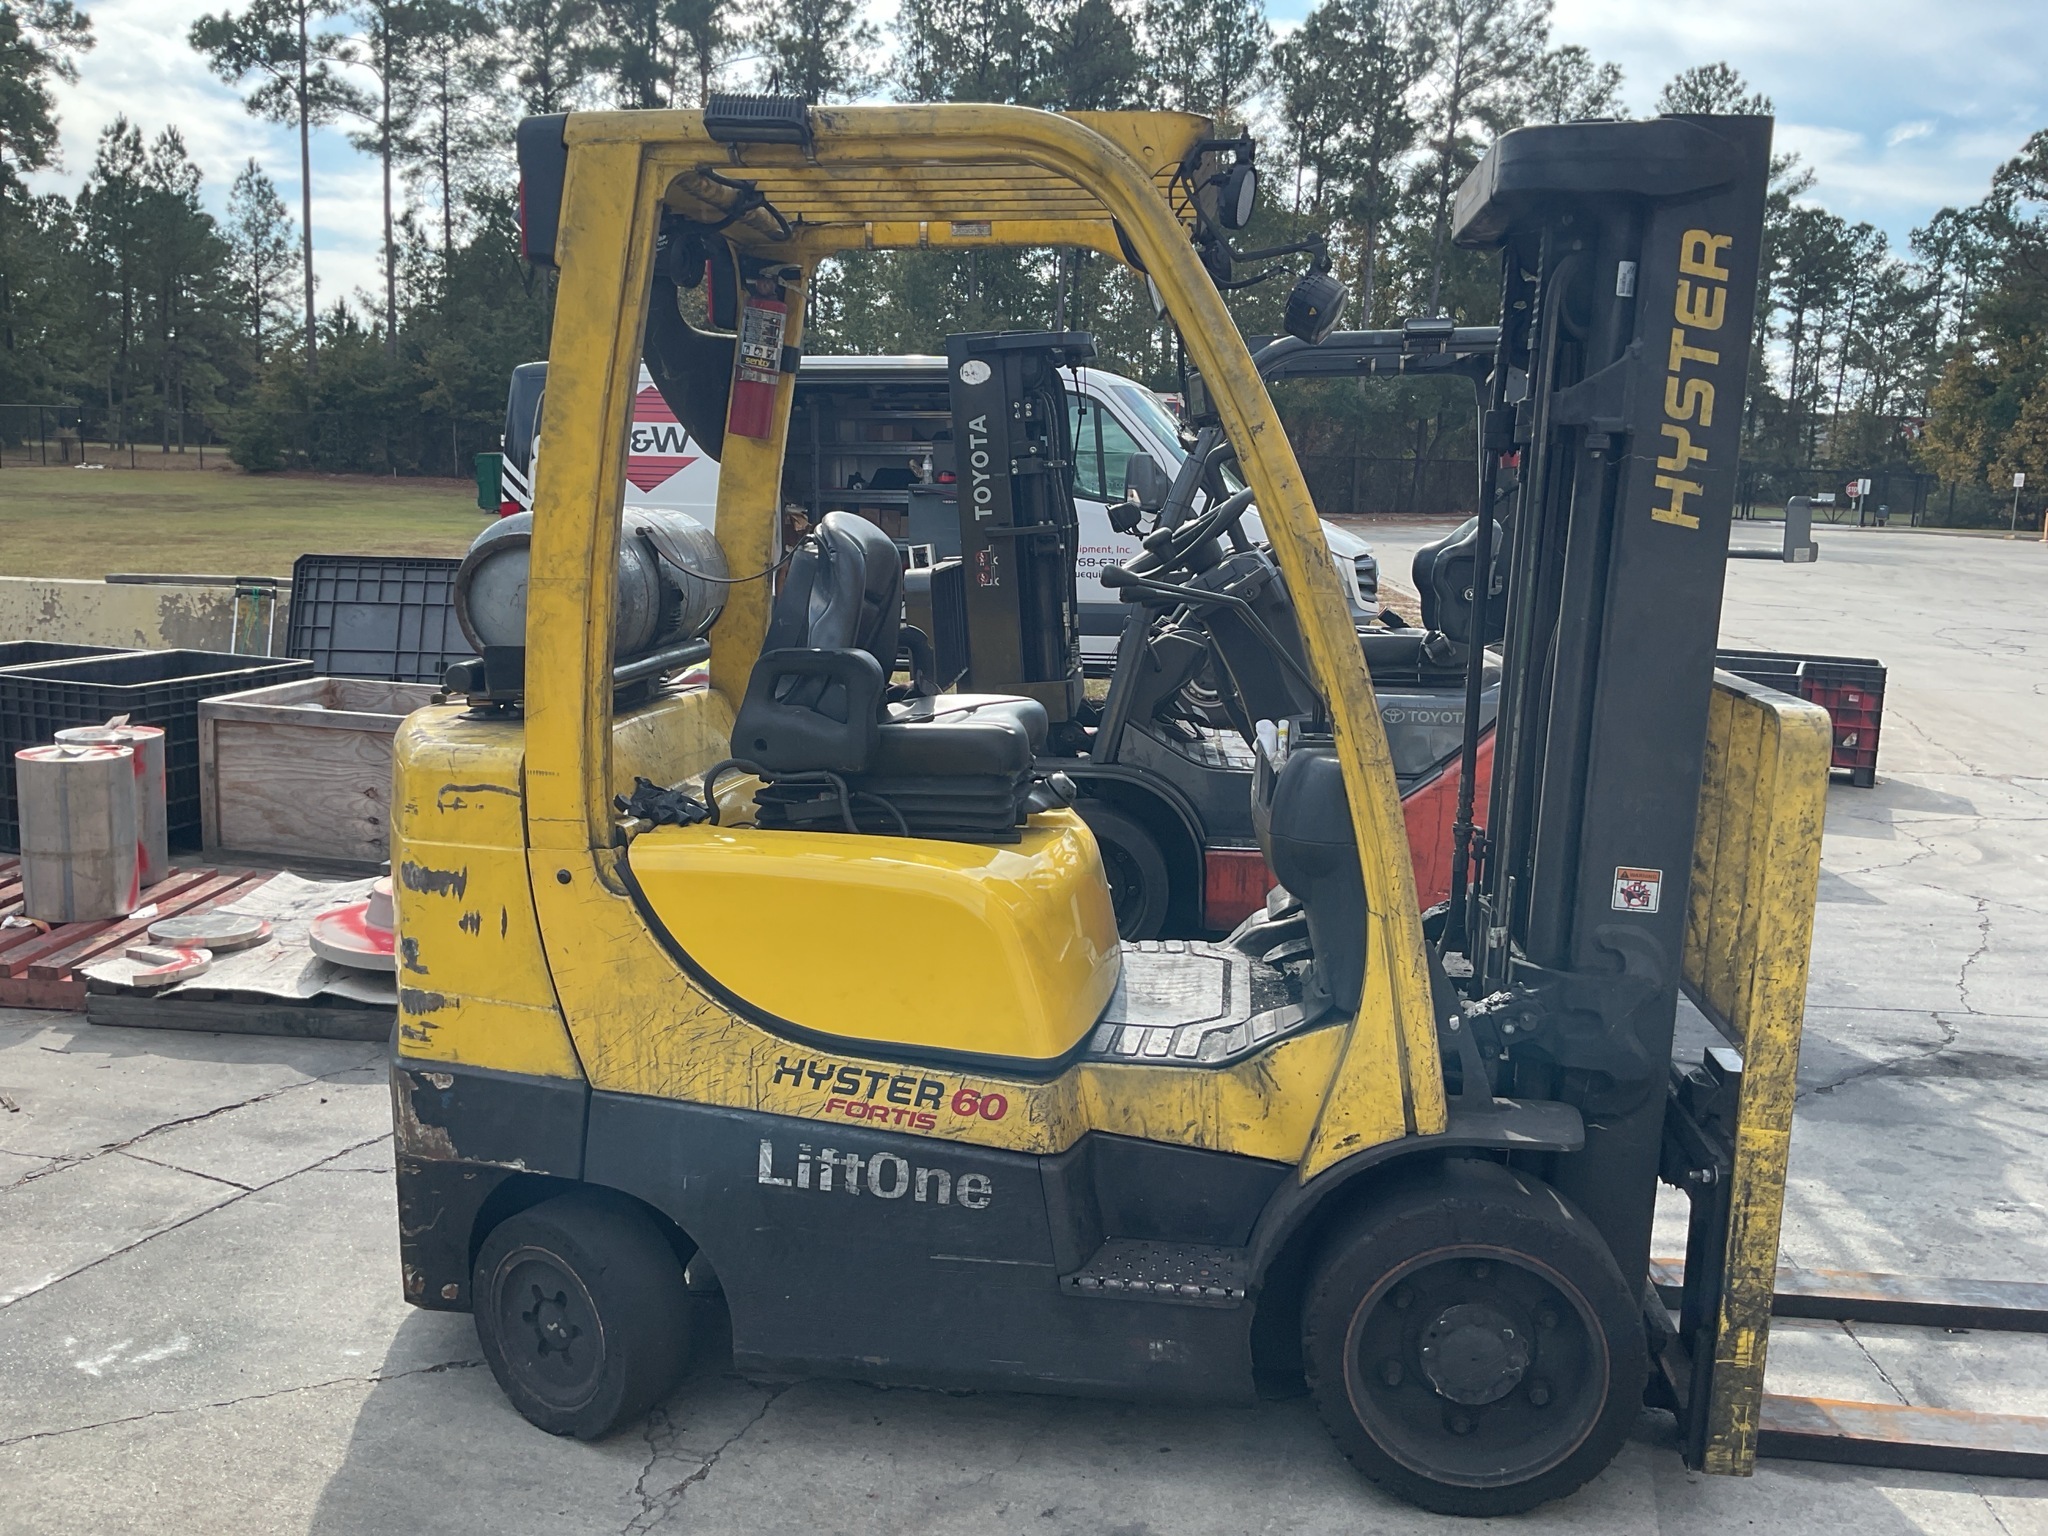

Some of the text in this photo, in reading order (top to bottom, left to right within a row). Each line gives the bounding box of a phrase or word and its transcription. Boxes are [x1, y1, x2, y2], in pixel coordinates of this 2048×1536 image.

[745, 356, 771, 368] sentry
[1651, 229, 1733, 530] HYSTER
[630, 426, 688, 454] &W
[968, 413, 993, 521] TOYOTA
[1077, 557, 1128, 568] 68-6316
[1079, 545, 1133, 555] ipment, Inc.
[1408, 711, 1465, 724] TOYOT
[1629, 872, 1658, 880] WARNING
[772, 1055, 1008, 1121] HYSTER 60
[825, 1098, 938, 1131] FORTIS
[757, 1137, 993, 1210] LiftOne
